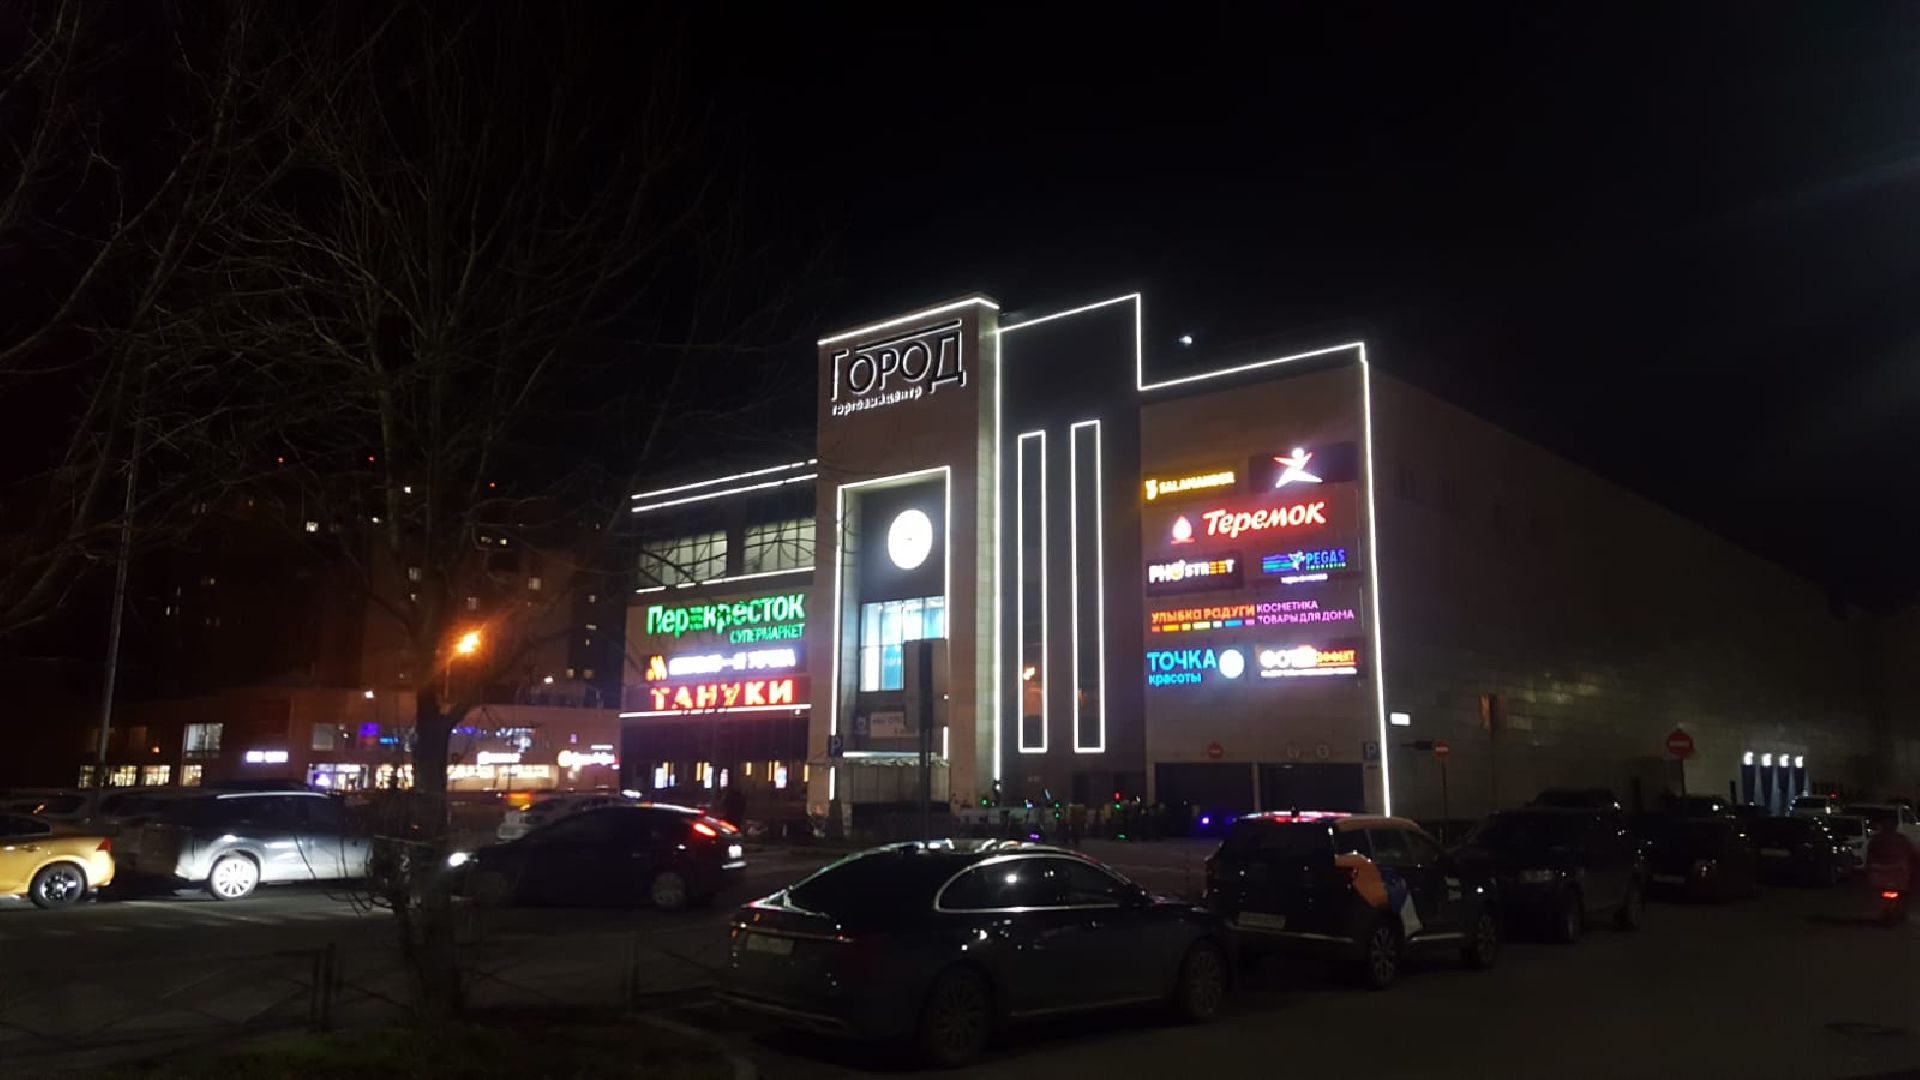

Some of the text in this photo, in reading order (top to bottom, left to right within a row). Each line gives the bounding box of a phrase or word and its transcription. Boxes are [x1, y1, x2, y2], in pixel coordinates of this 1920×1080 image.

[831, 318, 966, 402] ГОРОД
[1203, 501, 1326, 538] Теремок
[1305, 549, 1346, 566] PEGAS
[1256, 600, 1318, 613] КОСМЕТИКА
[1321, 609, 1354, 622] ДОМА
[730, 624, 805, 644] СУПЕРМАРКЕТ
[1147, 649, 1216, 671] ТОЧКА
[1149, 673, 1201, 687] красоты
[650, 680, 793, 711] ТАНУКИ
